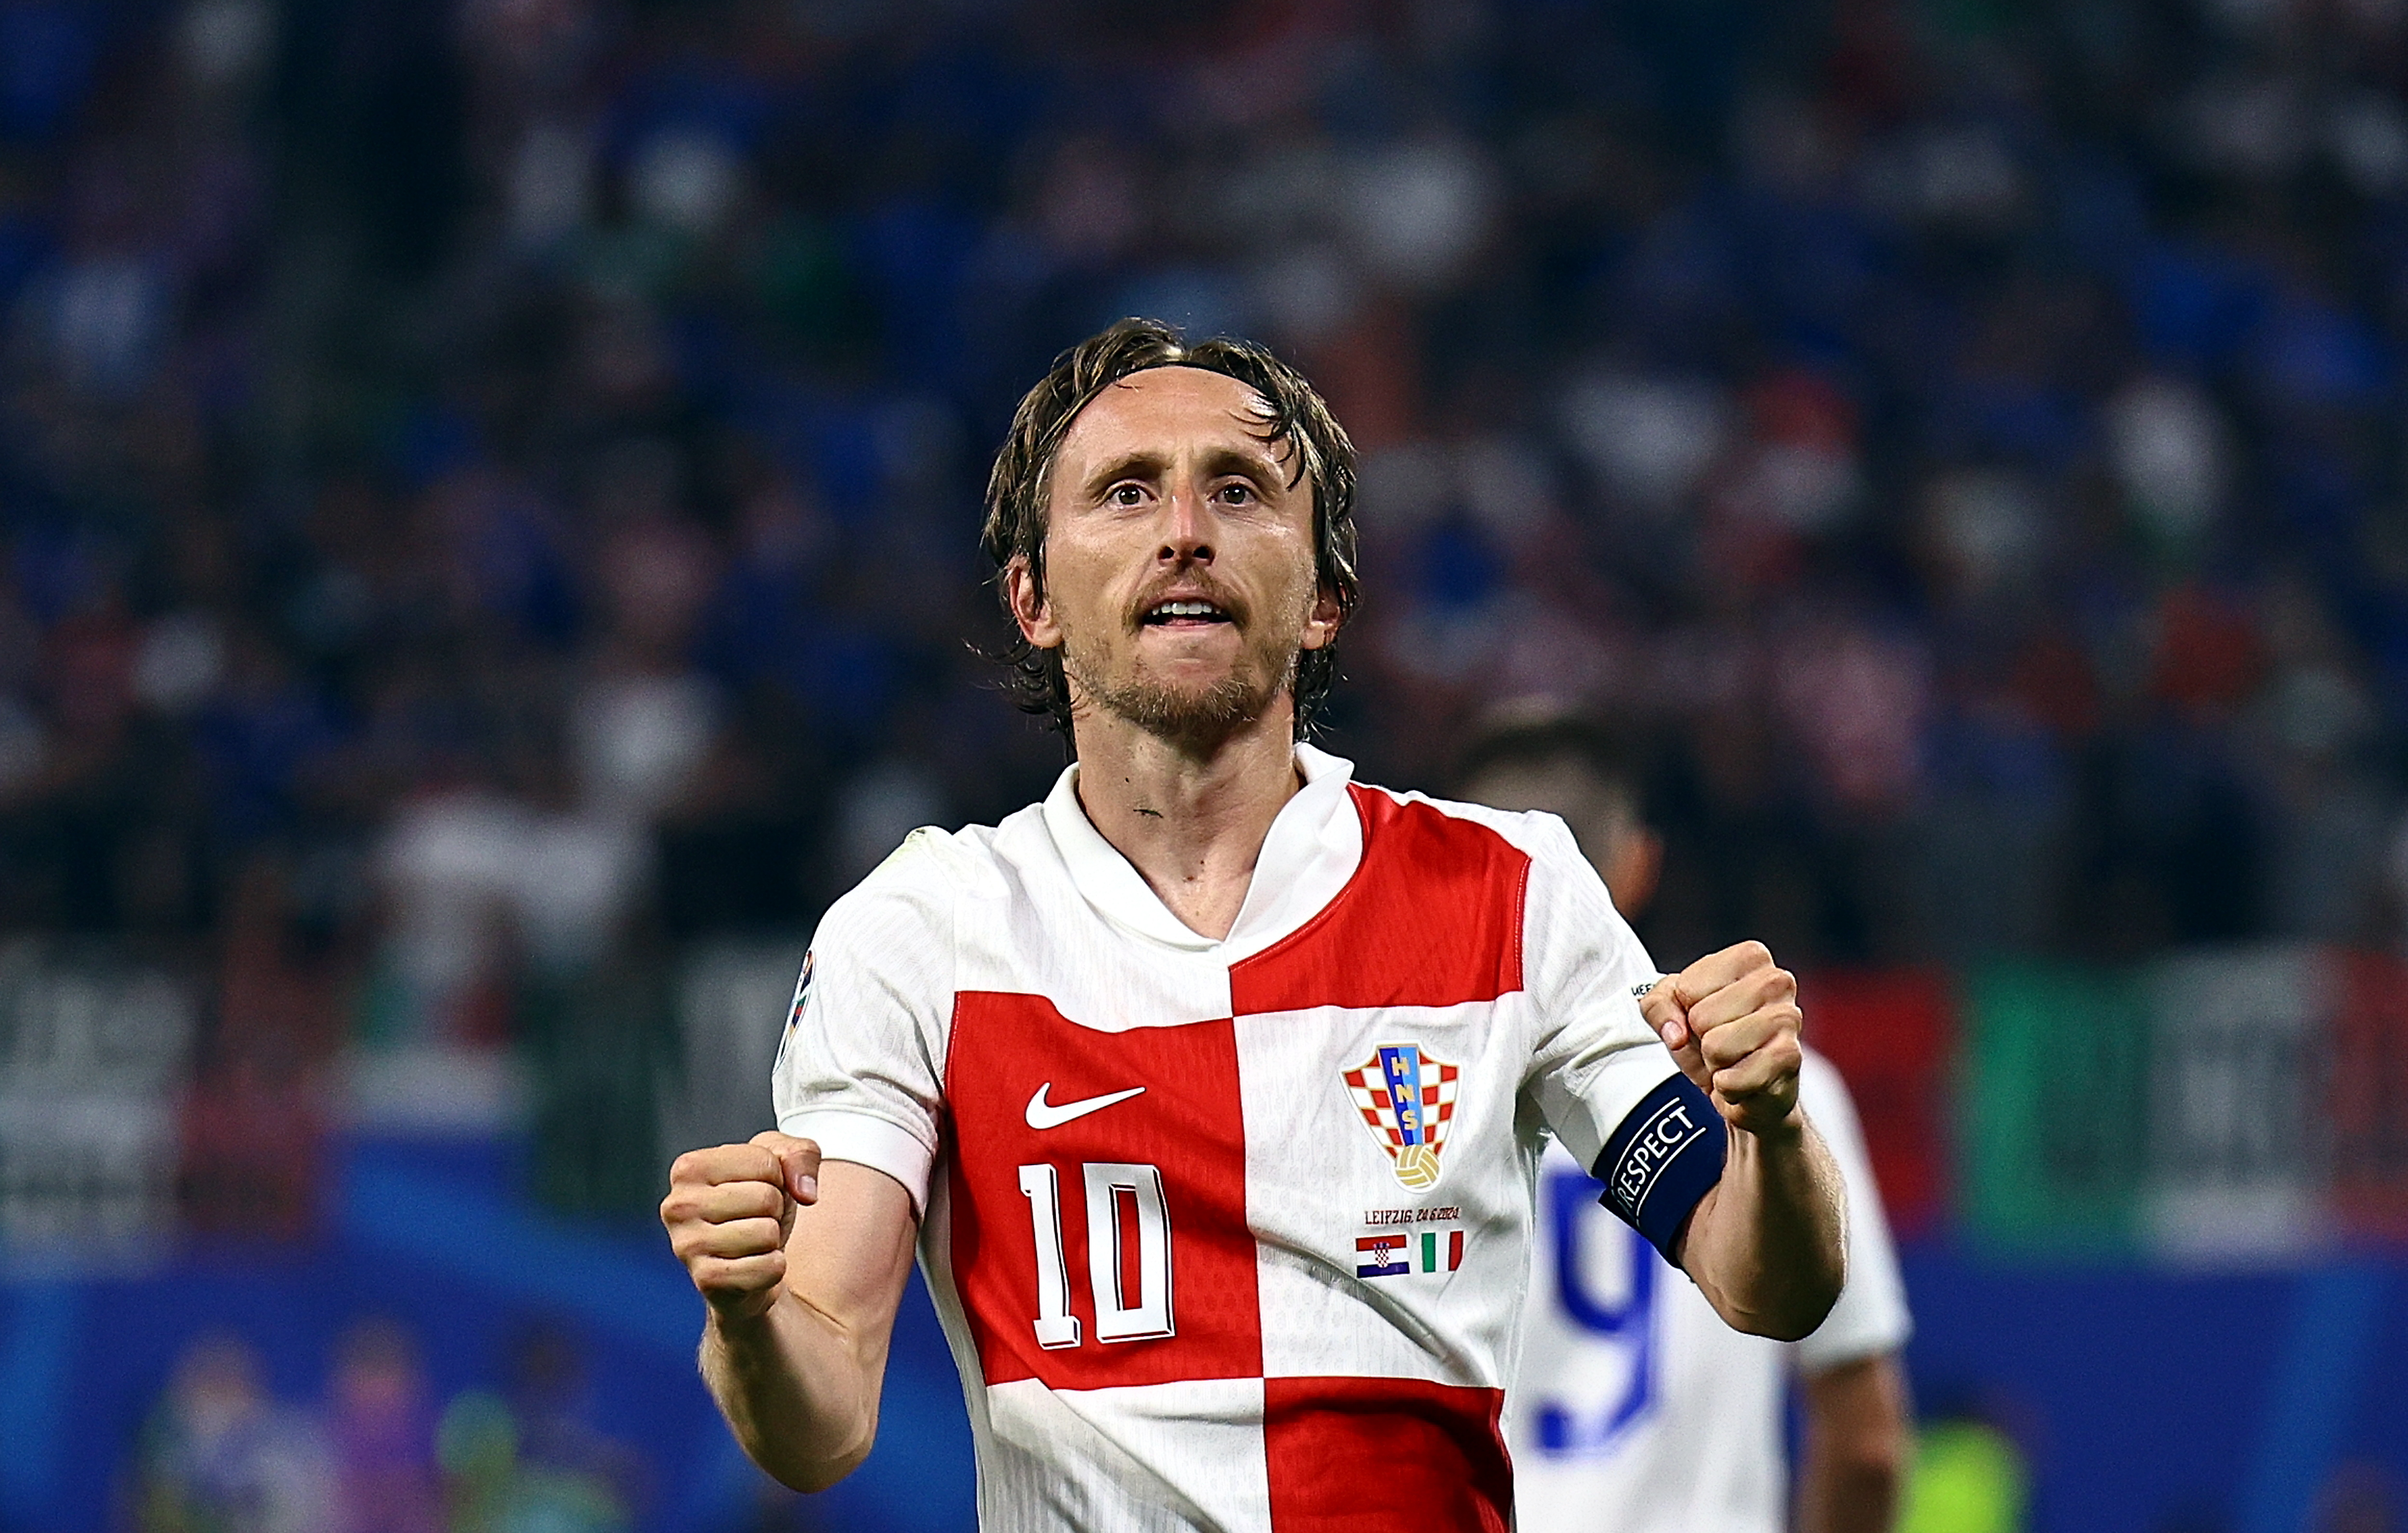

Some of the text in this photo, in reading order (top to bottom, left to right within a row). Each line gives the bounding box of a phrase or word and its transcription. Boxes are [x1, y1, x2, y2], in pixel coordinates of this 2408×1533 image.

[1631, 983, 1656, 996] UEF
[1391, 1056, 1418, 1130] HNS
[1617, 1105, 1693, 1208] RESPECT
[1018, 1162, 1175, 1350] 10
[1365, 1209, 1413, 1225] LEIPZIG,
[1534, 1167, 1662, 1459] 9
